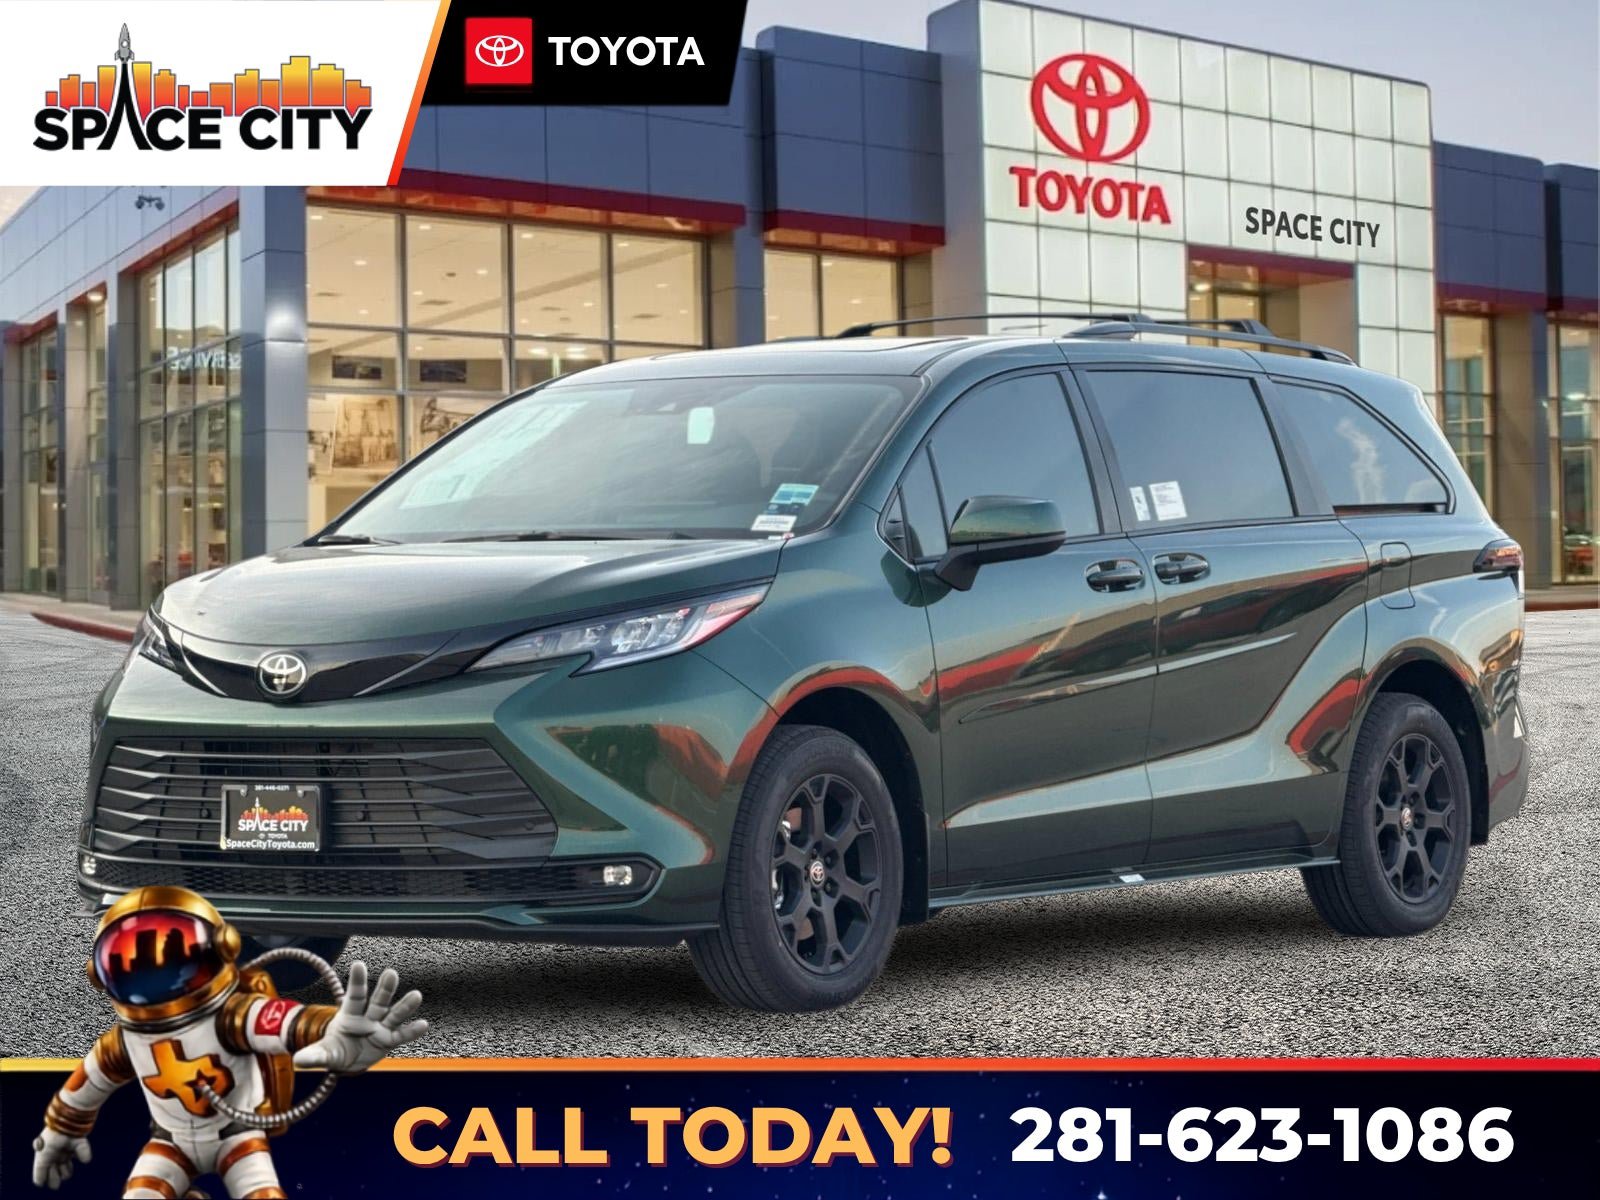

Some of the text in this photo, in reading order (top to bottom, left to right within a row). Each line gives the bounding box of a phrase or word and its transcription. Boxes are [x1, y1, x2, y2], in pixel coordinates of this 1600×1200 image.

[1009, 165, 1171, 225] TOYOTA
[1245, 206, 1381, 248] SPACE CITY
[237, 819, 309, 832] SPACE CITY
[226, 839, 315, 850] SpaceCityToyota.com
